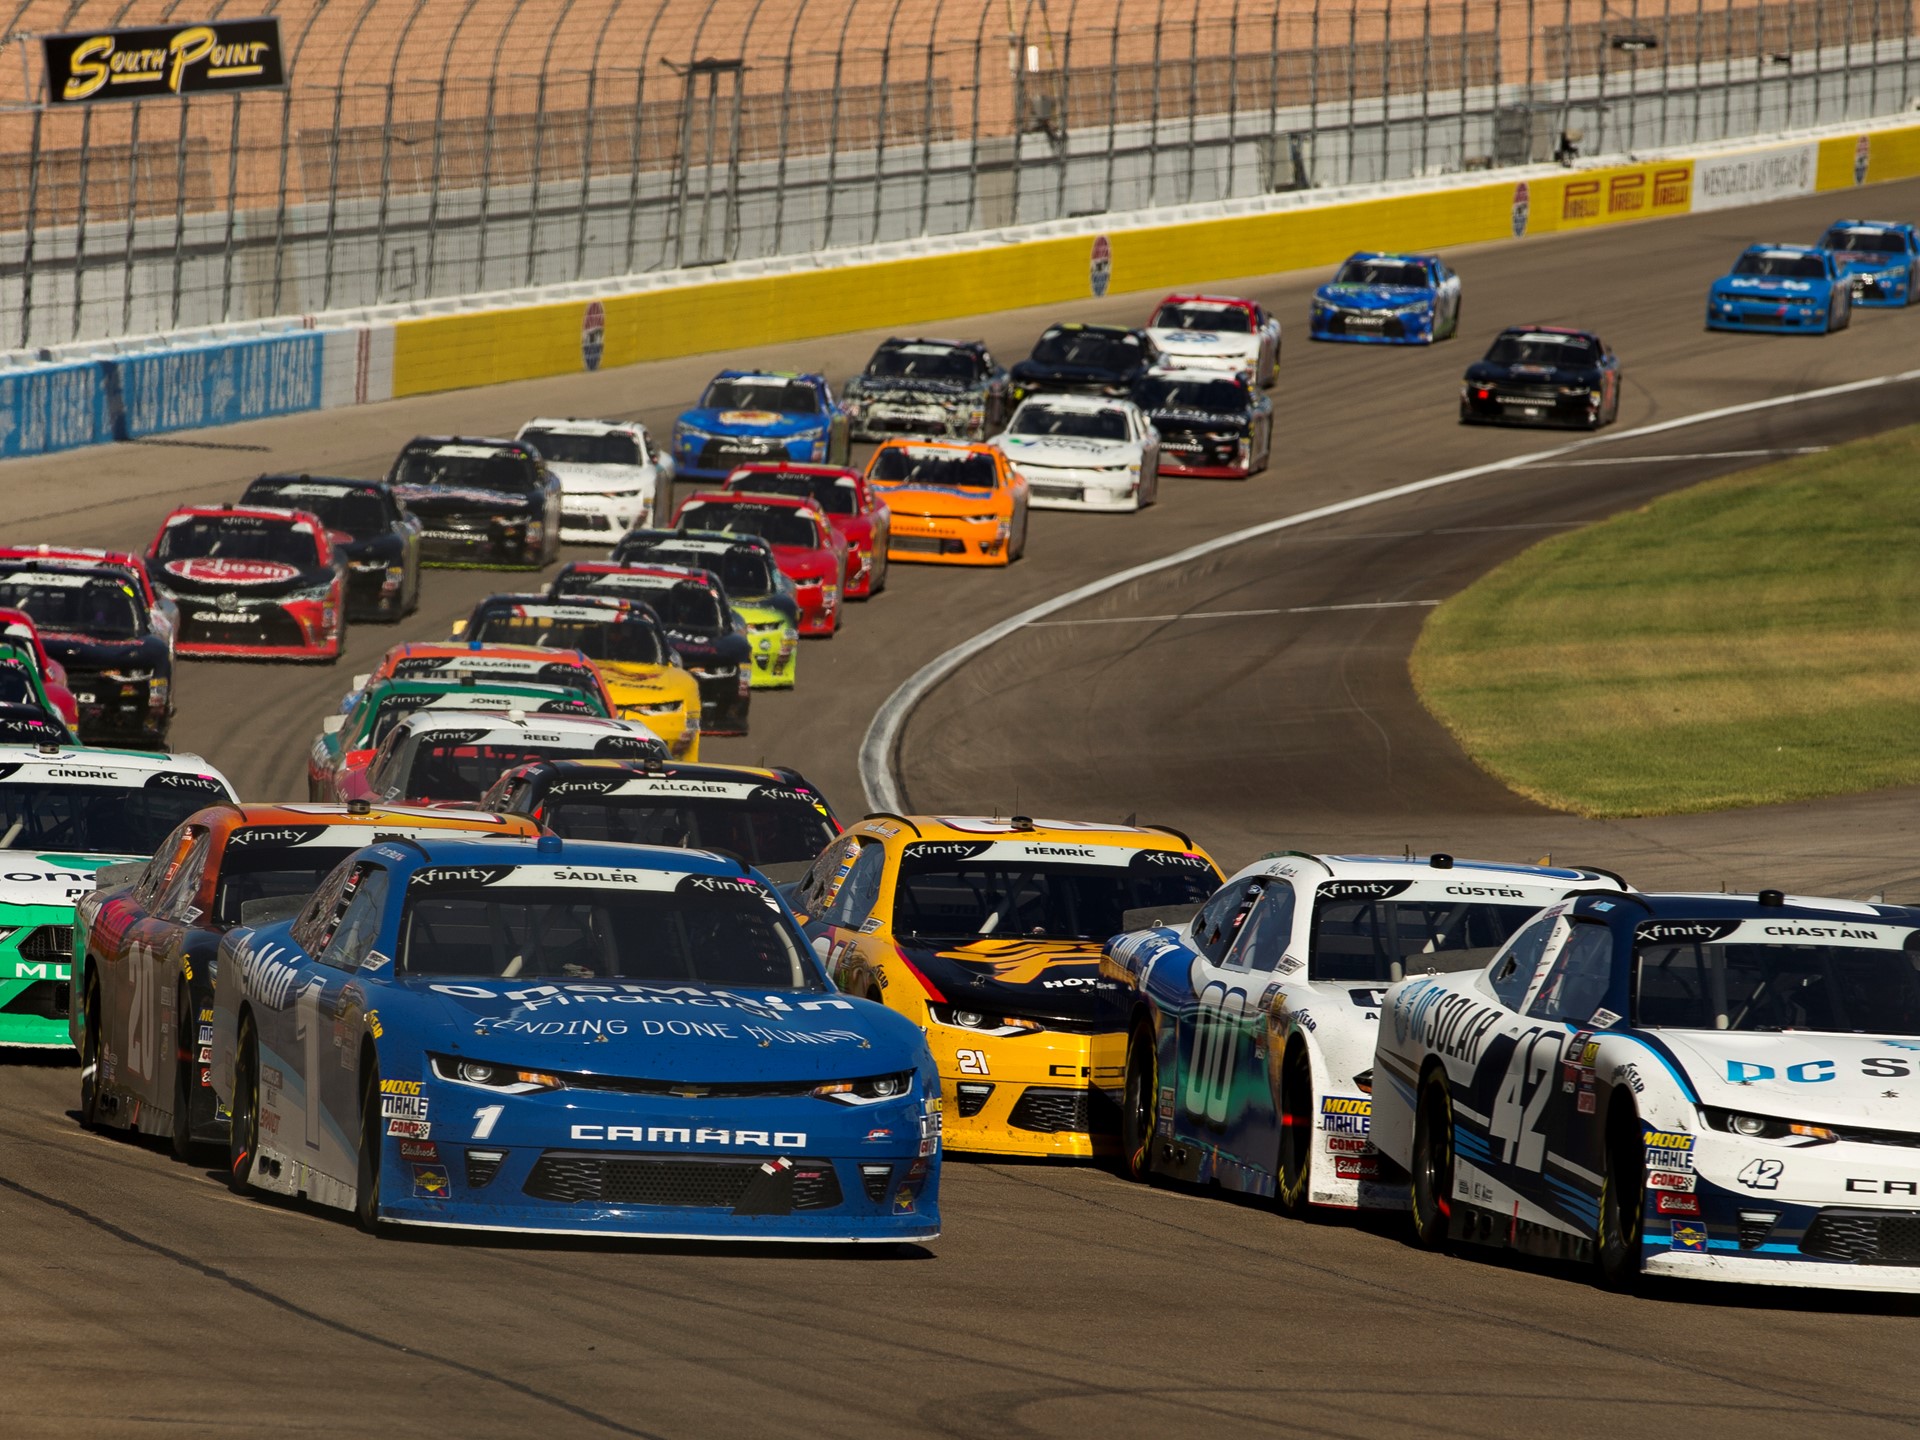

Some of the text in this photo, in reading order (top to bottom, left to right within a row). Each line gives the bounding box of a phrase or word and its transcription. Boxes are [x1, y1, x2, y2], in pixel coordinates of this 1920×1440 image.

[459, 660, 531, 669] GALLAGHER
[381, 695, 432, 706] xfinity
[470, 697, 512, 705] JONES
[7, 720, 61, 737] xfinity
[422, 731, 662, 752] xfinity REED xfinity
[48, 769, 221, 793] CINDRIC xfinity
[549, 781, 820, 805] xfinity ALLGAIER xfinity
[229, 829, 307, 846] xfinity
[904, 844, 1211, 872] xfinity HEMRIC xfinity
[411, 868, 769, 899] xfinity SADLER xfinity
[1316, 883, 1525, 898] xfinity CUSTER
[1637, 925, 1878, 941] xfinity CHASTAIN
[127, 940, 155, 1081] 20
[473, 1016, 866, 1045] LENDING DONE HUMAN
[956, 1049, 990, 1075] 21
[1727, 1060, 1836, 1083] DC
[380, 1079, 422, 1095] MOOG
[383, 1096, 428, 1116] MAHLE
[1323, 1097, 1372, 1116] MOOG
[1490, 1027, 1564, 1174] 42
[390, 1121, 420, 1134] COMP
[471, 1105, 505, 1140] 1
[1323, 1115, 1370, 1134] MAHLE
[571, 1125, 807, 1148] CAMARO
[1329, 1138, 1365, 1151] COMP
[1643, 1131, 1693, 1150] MOOG
[1337, 1160, 1379, 1176] Edelbrock
[1647, 1149, 1693, 1169] MAHLE
[416, 1176, 448, 1187] SUNOCO
[1651, 1173, 1685, 1187] COMP
[1737, 1158, 1784, 1191] 42
